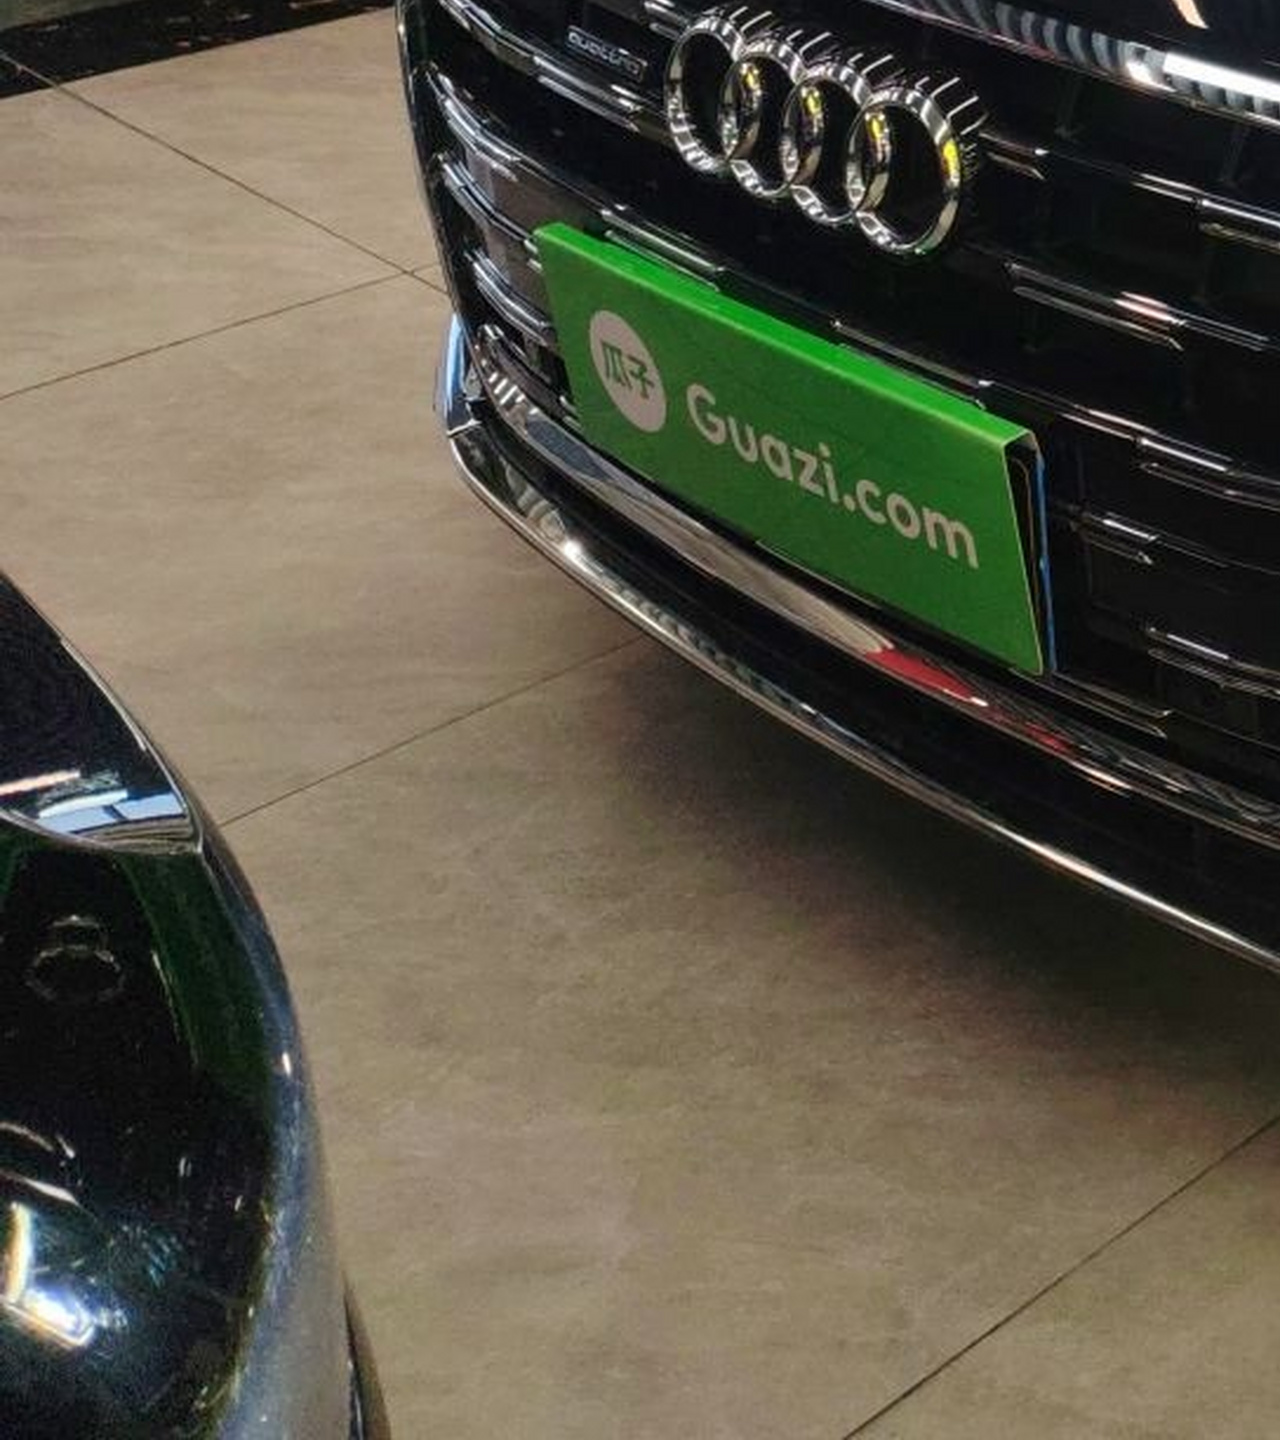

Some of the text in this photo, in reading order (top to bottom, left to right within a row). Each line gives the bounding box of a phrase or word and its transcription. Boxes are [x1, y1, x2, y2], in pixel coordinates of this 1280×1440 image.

[568, 30, 641, 76] quattro
[601, 341, 655, 400] 瓜子
[686, 383, 980, 570] Guazi.com
